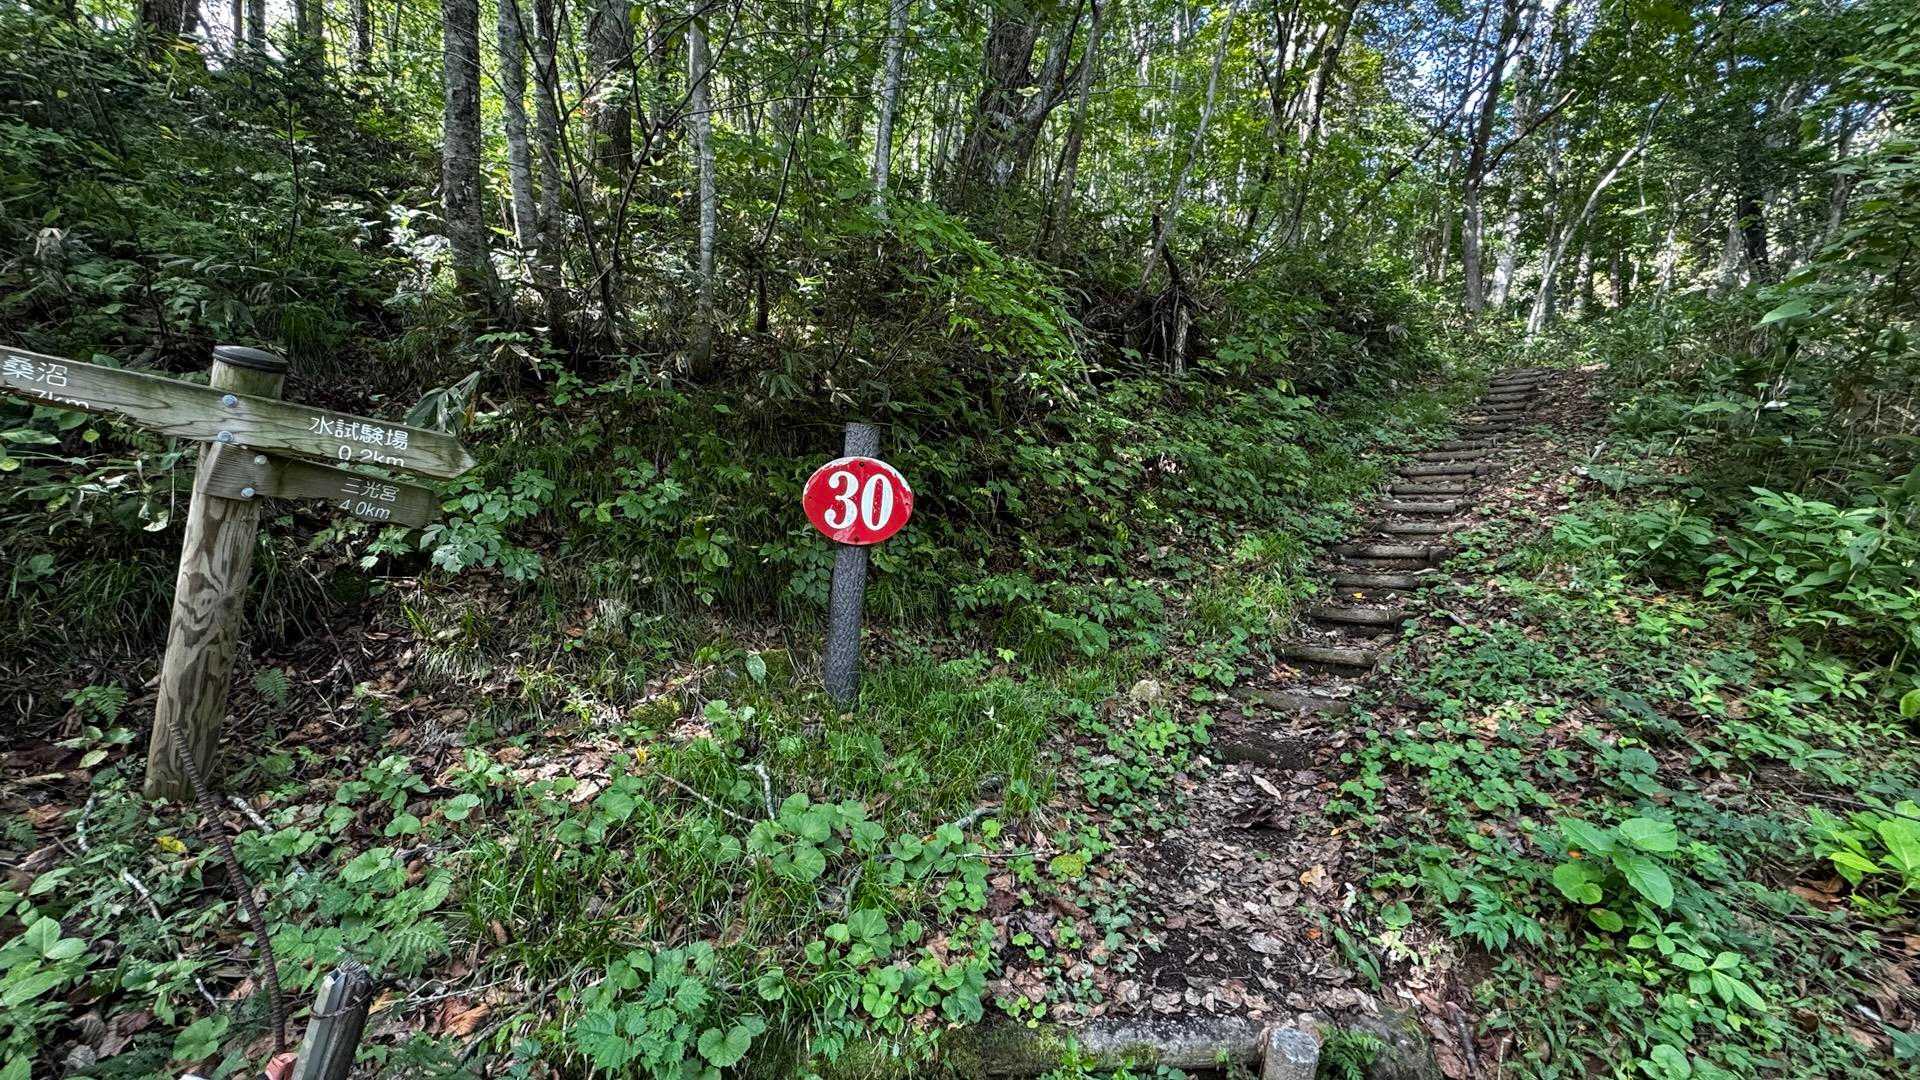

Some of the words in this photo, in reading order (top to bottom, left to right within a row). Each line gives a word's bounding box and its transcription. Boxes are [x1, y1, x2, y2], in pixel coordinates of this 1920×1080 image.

[3, 355, 67, 386] 桑沼
[309, 416, 408, 449] 水試験場
[339, 445, 404, 467] 02km
[341, 477, 399, 501] 三光宮
[824, 471, 894, 531] 30
[339, 499, 390, 519] 4.0km
